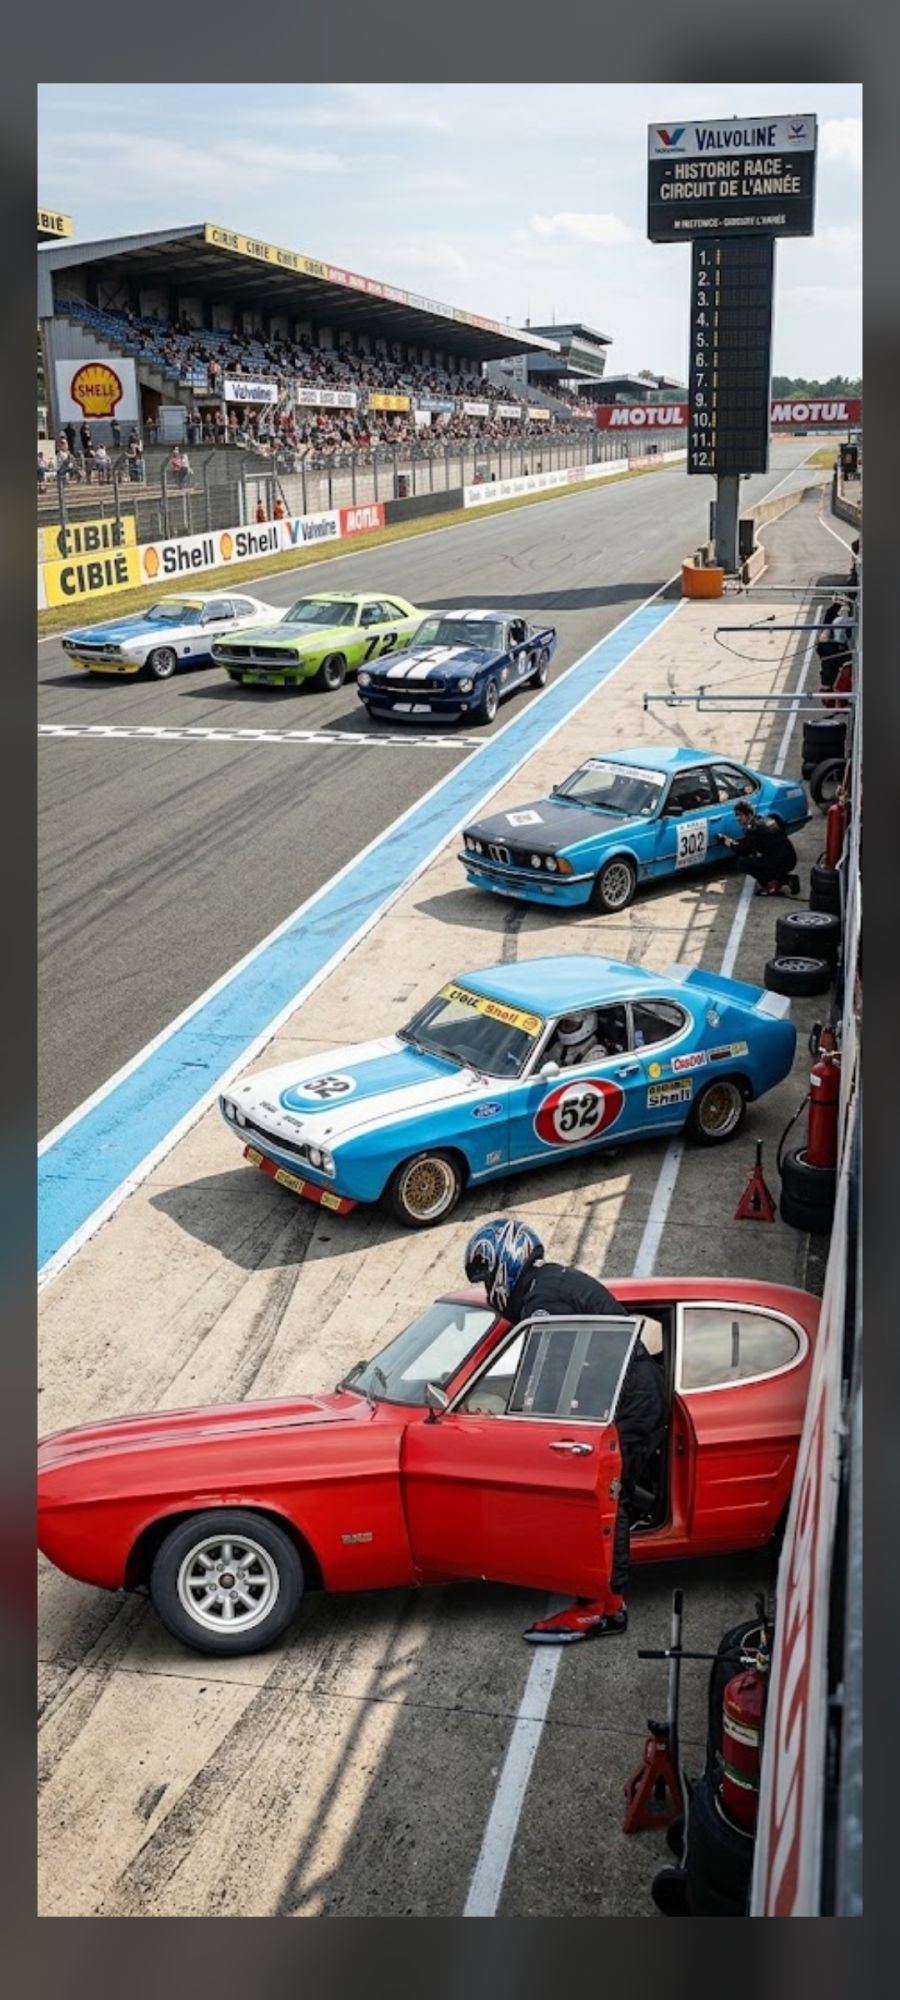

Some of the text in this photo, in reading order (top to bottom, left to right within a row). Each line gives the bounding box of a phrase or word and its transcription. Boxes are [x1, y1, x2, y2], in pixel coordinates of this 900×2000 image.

[695, 124, 778, 151] VALVOLINE
[675, 161, 740, 180] HISTORIC
[744, 158, 782, 176] RACE
[660, 174, 801, 200] CIRCUIT DE L'ANNÉE
[699, 251, 711, 265] 1.
[698, 272, 710, 286] 2.
[697, 292, 709, 306] 3.
[696, 313, 709, 327] 4.
[696, 333, 709, 347] 5.
[695, 354, 708, 367] 6.
[695, 373, 708, 387] 7.
[695, 393, 707, 407] 9.
[609, 407, 684, 426] MOTUL
[692, 413, 711, 427] 10.
[771, 402, 849, 422] MOTUL
[692, 432, 711, 447] 11.
[691, 452, 711, 466] 12.
[346, 506, 380, 532] MOTUL
[235, 527, 278, 557] Shell
[162, 539, 215, 573] Shell
[60, 553, 128, 596] CIBIÉ
[364, 633, 398, 661] 72
[680, 831, 705, 858] 302
[304, 1076, 350, 1099] 52
[559, 1092, 599, 1132] 52
